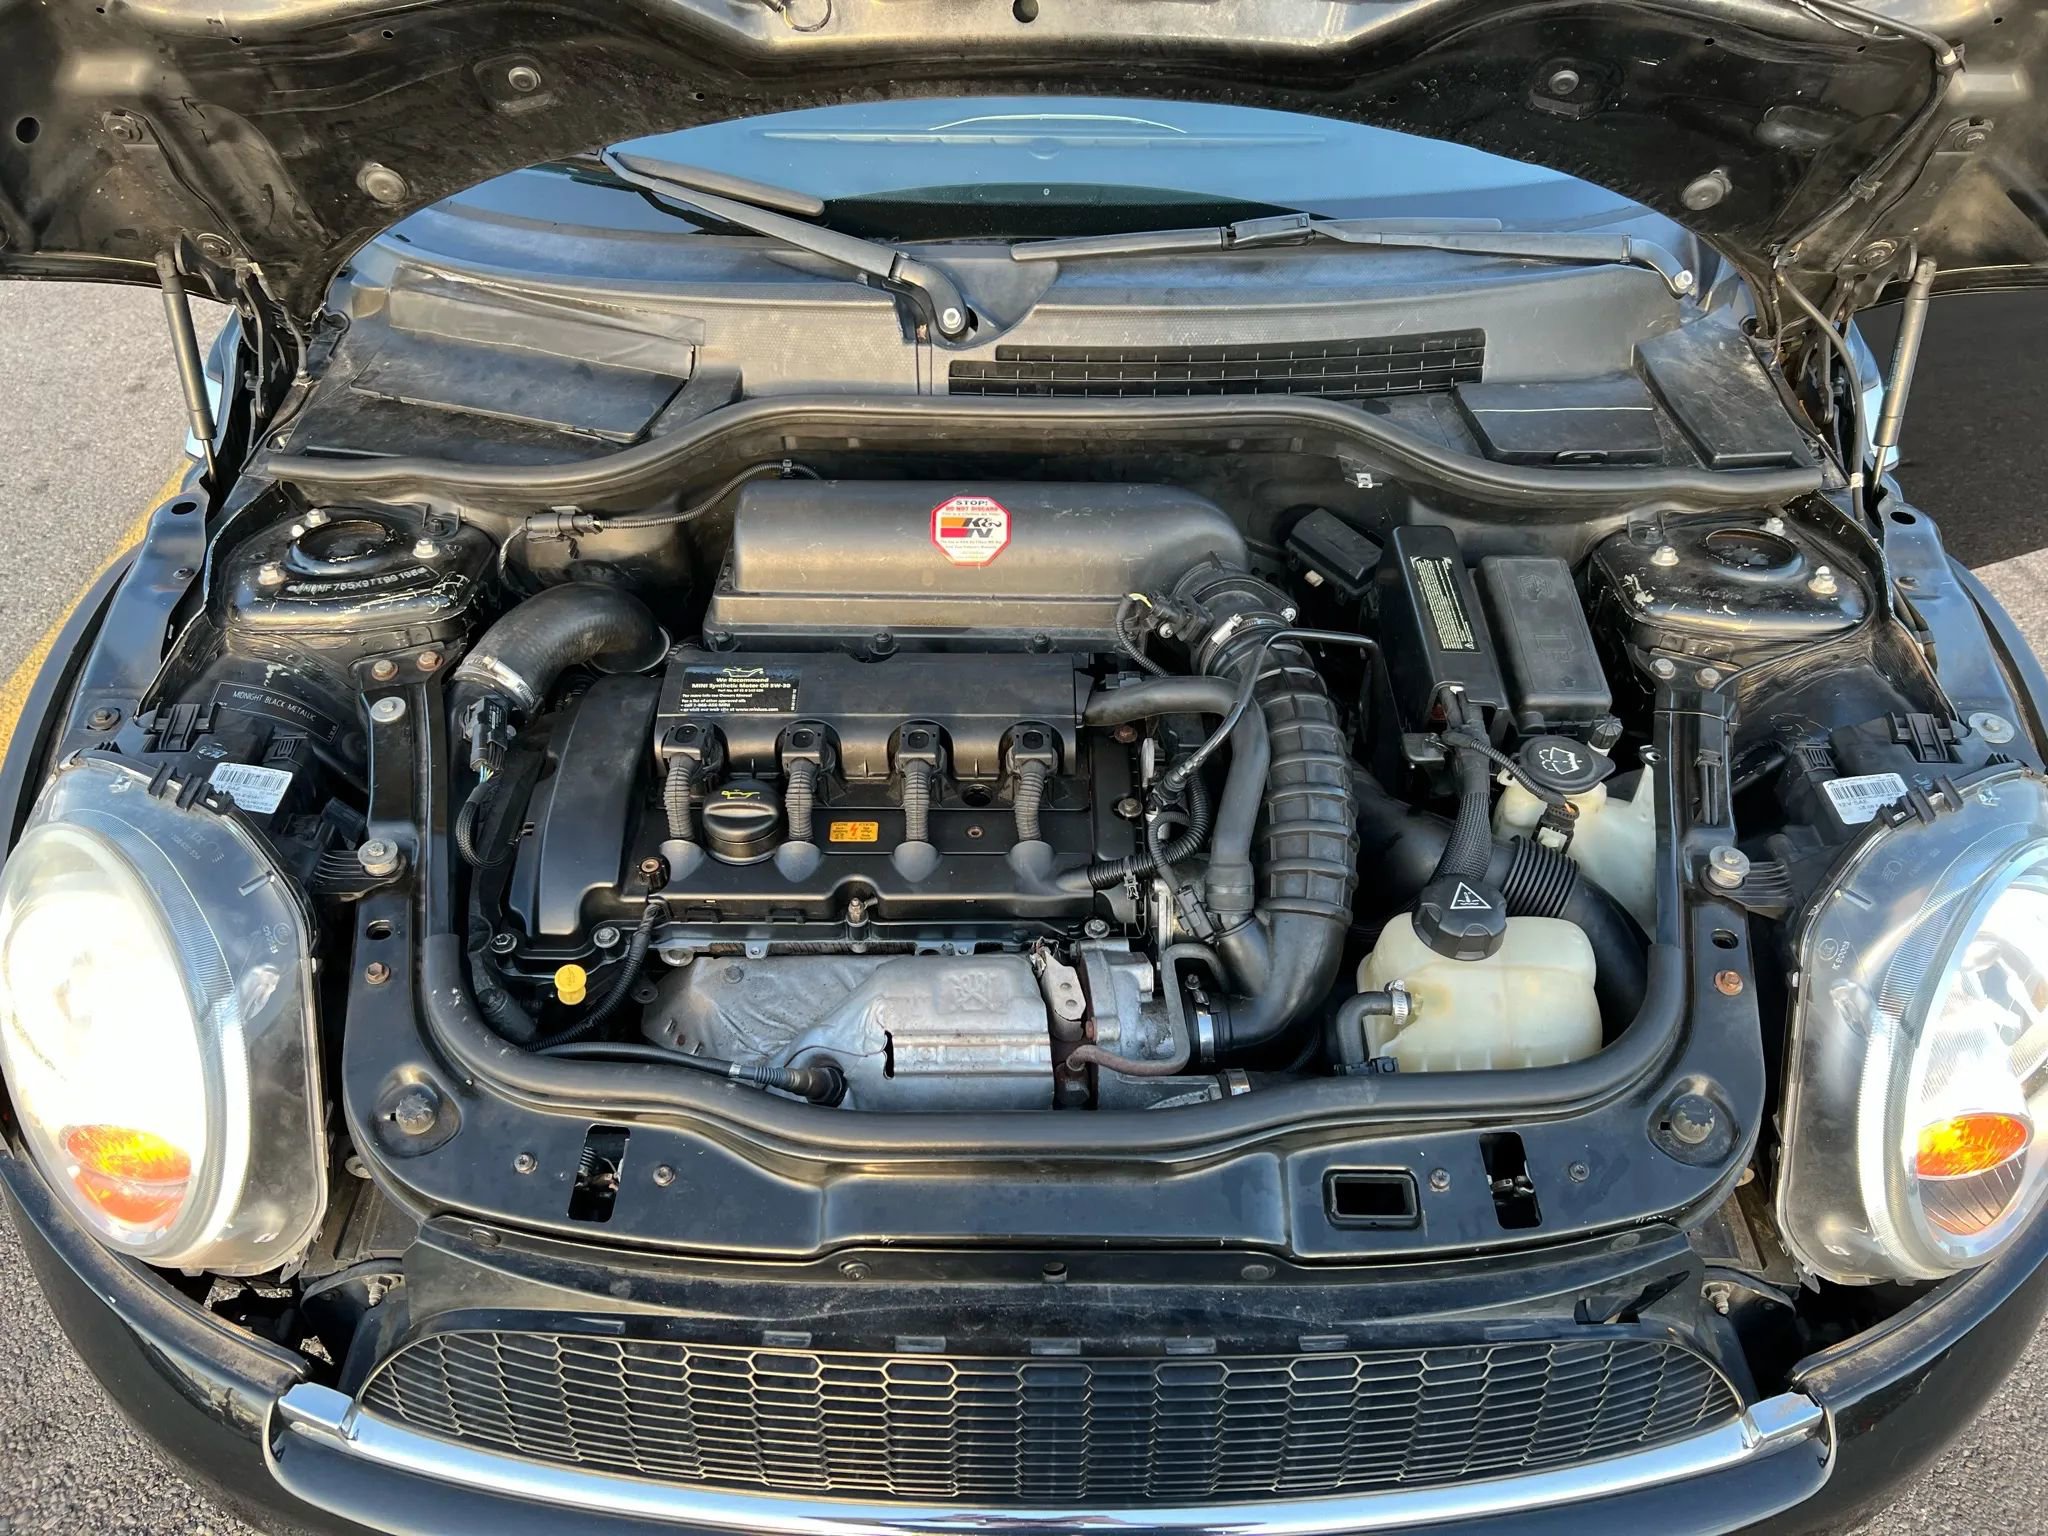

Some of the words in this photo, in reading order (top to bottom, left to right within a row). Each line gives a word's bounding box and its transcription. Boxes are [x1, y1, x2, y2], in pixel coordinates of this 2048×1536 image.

[232, 690, 264, 702] MIDNIGHT
[264, 695, 287, 709] BLACK
[287, 703, 317, 722] METALLIC
